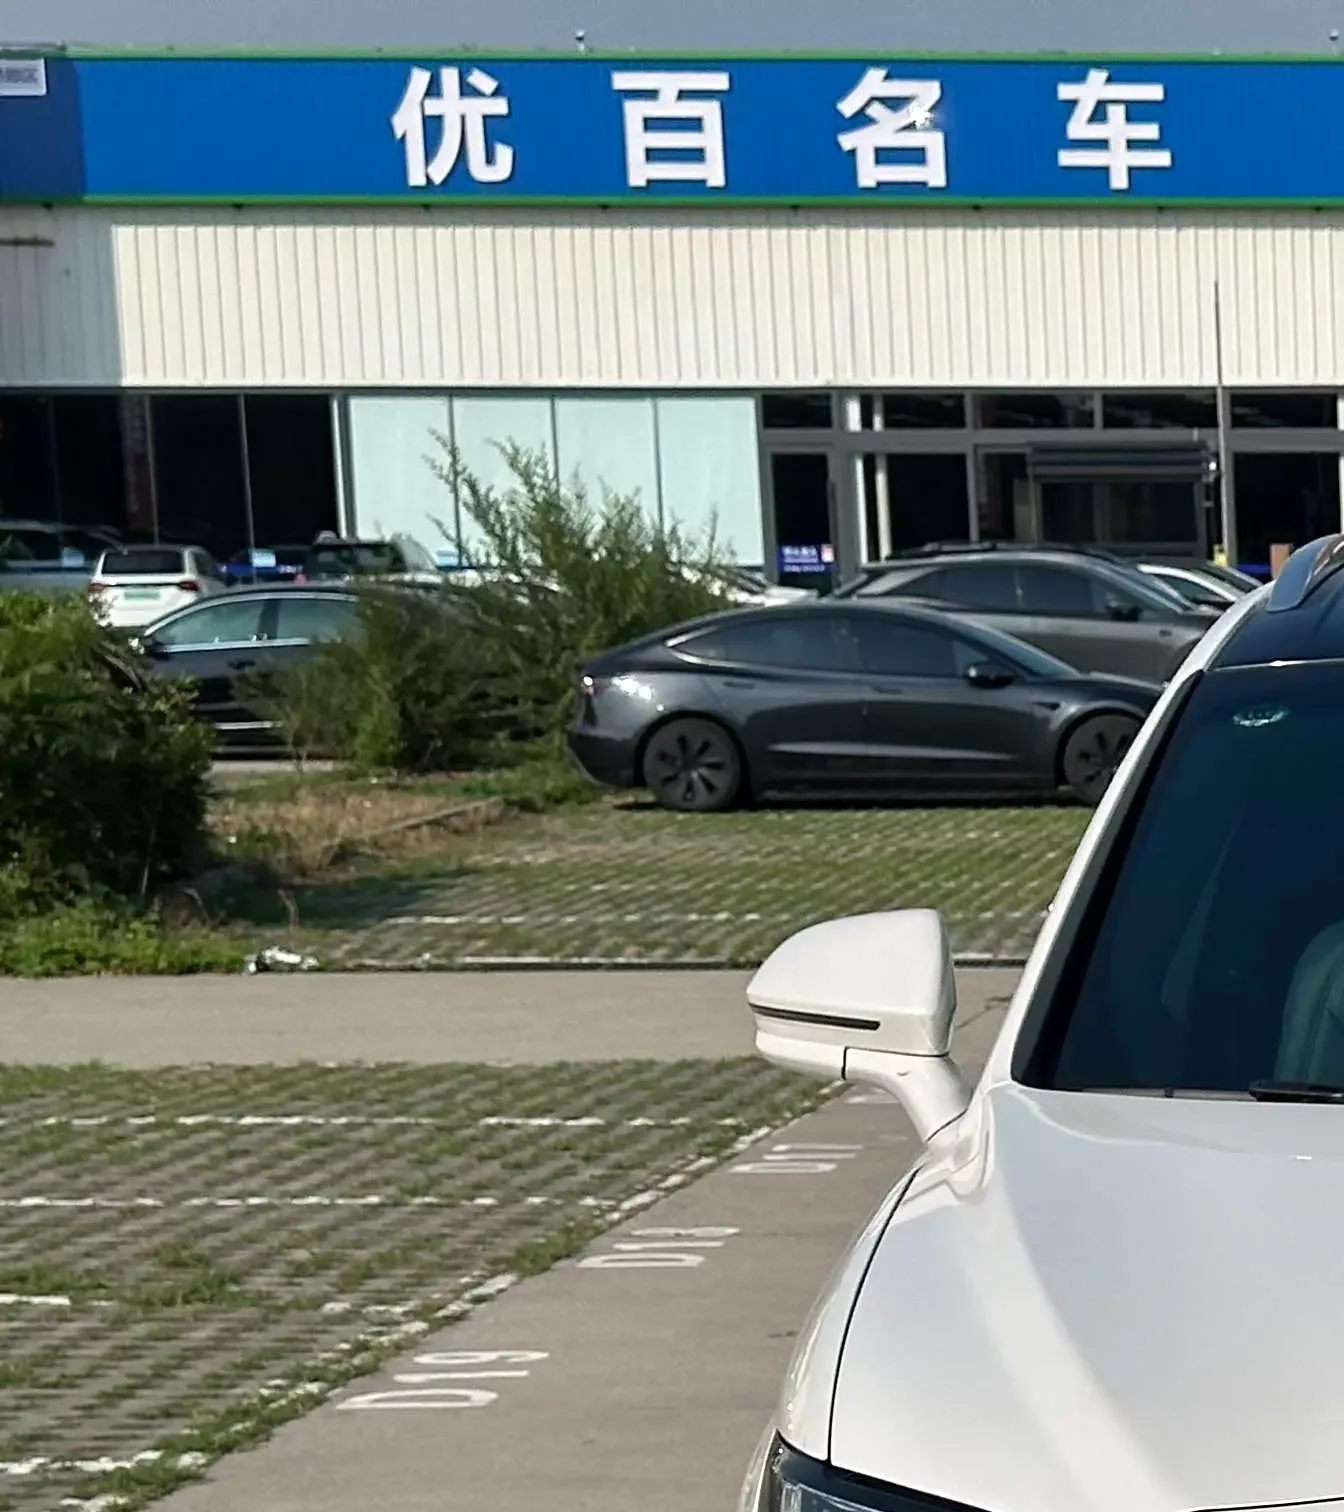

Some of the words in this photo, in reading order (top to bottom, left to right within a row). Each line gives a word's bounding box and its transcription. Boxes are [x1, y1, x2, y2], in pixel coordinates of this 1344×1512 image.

[391, 66, 1172, 191] 优百名车
[335, 1350, 550, 1410] D19
